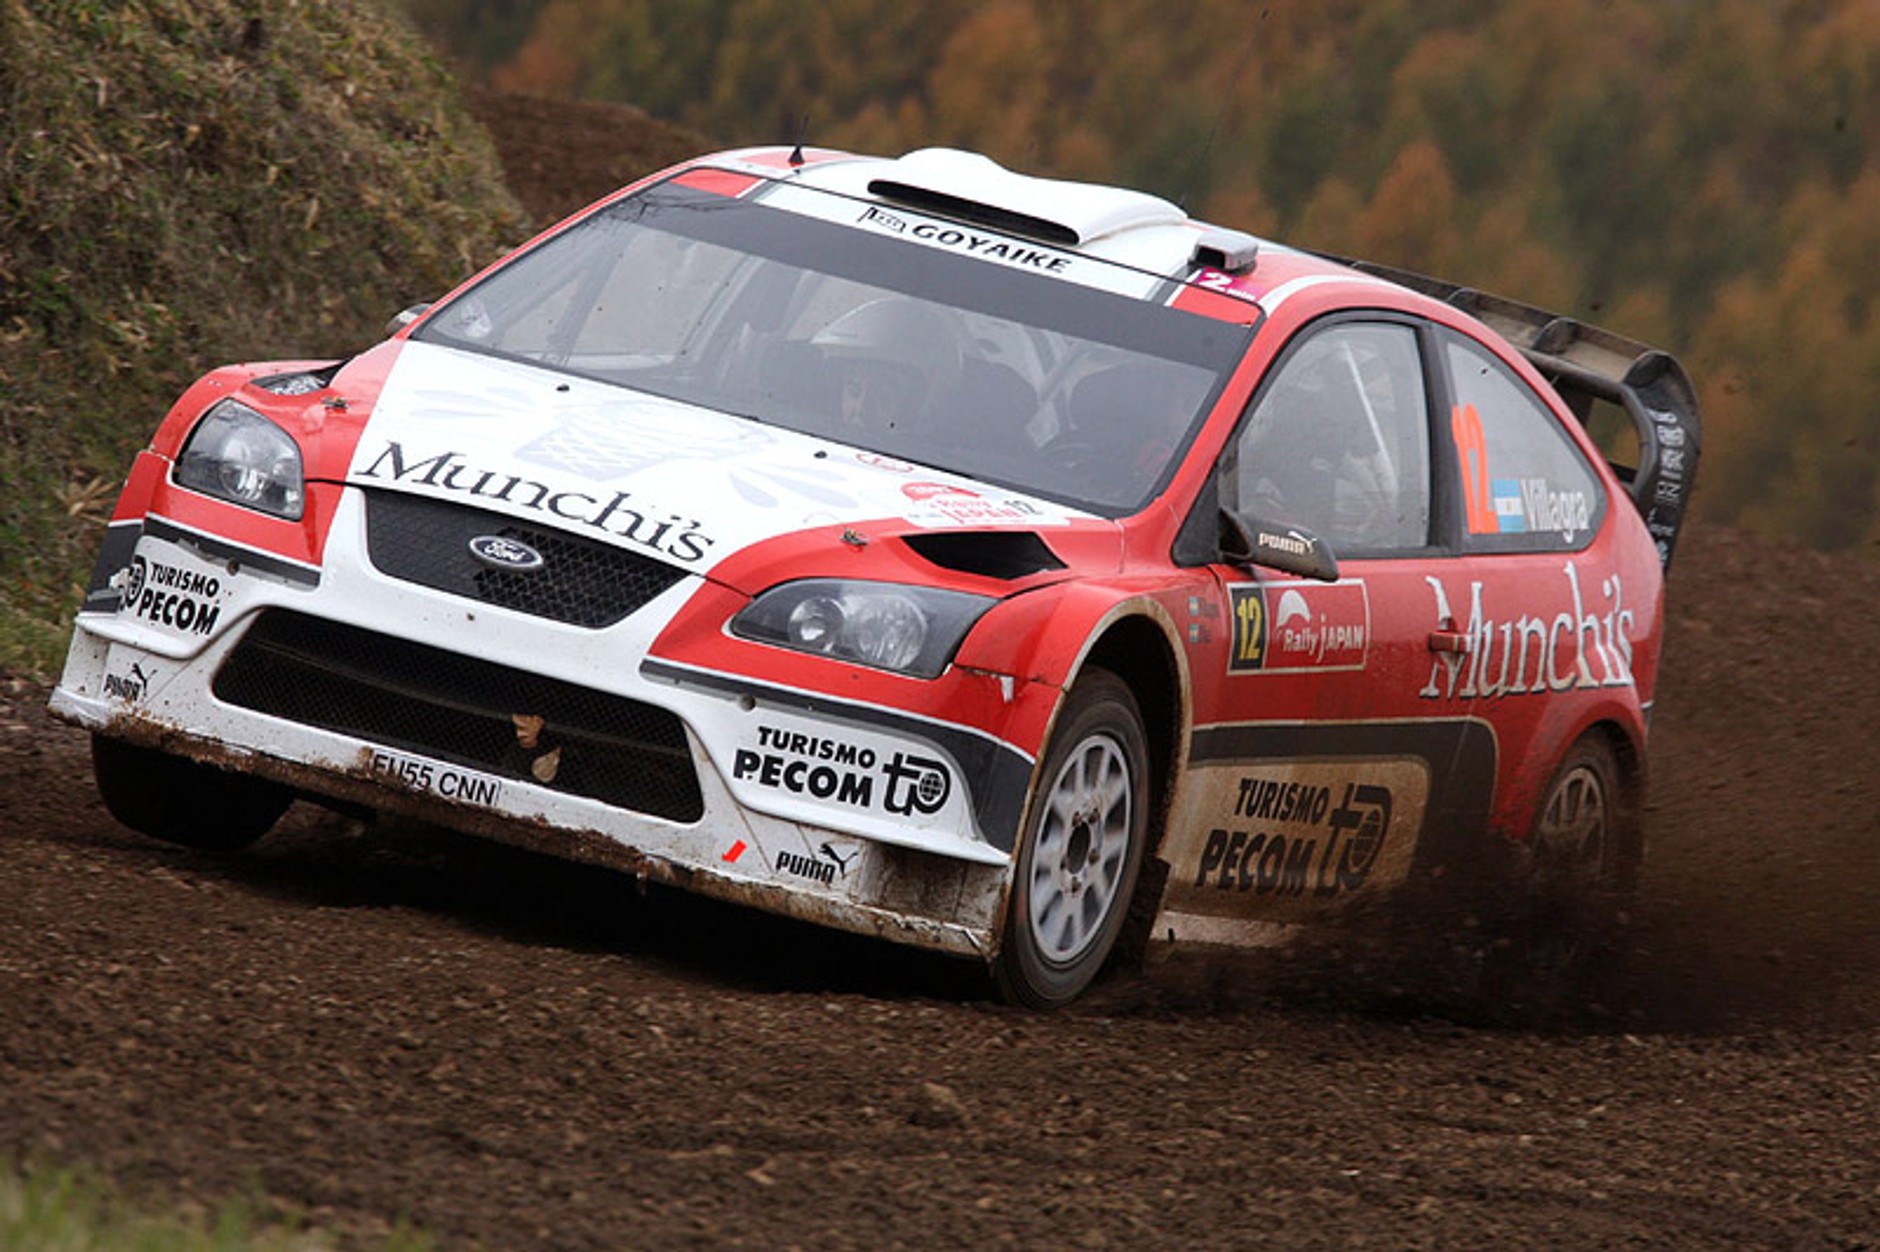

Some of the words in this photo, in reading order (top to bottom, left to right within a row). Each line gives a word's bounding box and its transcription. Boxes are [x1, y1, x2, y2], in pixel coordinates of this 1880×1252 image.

[912, 222, 1073, 273] GOYAIKE
[1452, 403, 1498, 534] 12
[355, 440, 716, 562] Munchi's
[1520, 478, 1589, 543] Villagra
[484, 541, 526, 561] Ford
[150, 561, 219, 597] TURISMO
[137, 588, 220, 635] PECOM
[1237, 597, 1262, 660] 12
[1419, 560, 1636, 698] Munchi's
[1284, 627, 1318, 656] Rally
[757, 726, 876, 769] TURISMO
[438, 773, 496, 804] CNN
[733, 750, 873, 806] PECOM
[1234, 778, 1330, 826] TURISMO
[776, 851, 836, 883] PUMA
[1195, 829, 1316, 897] PECOM
